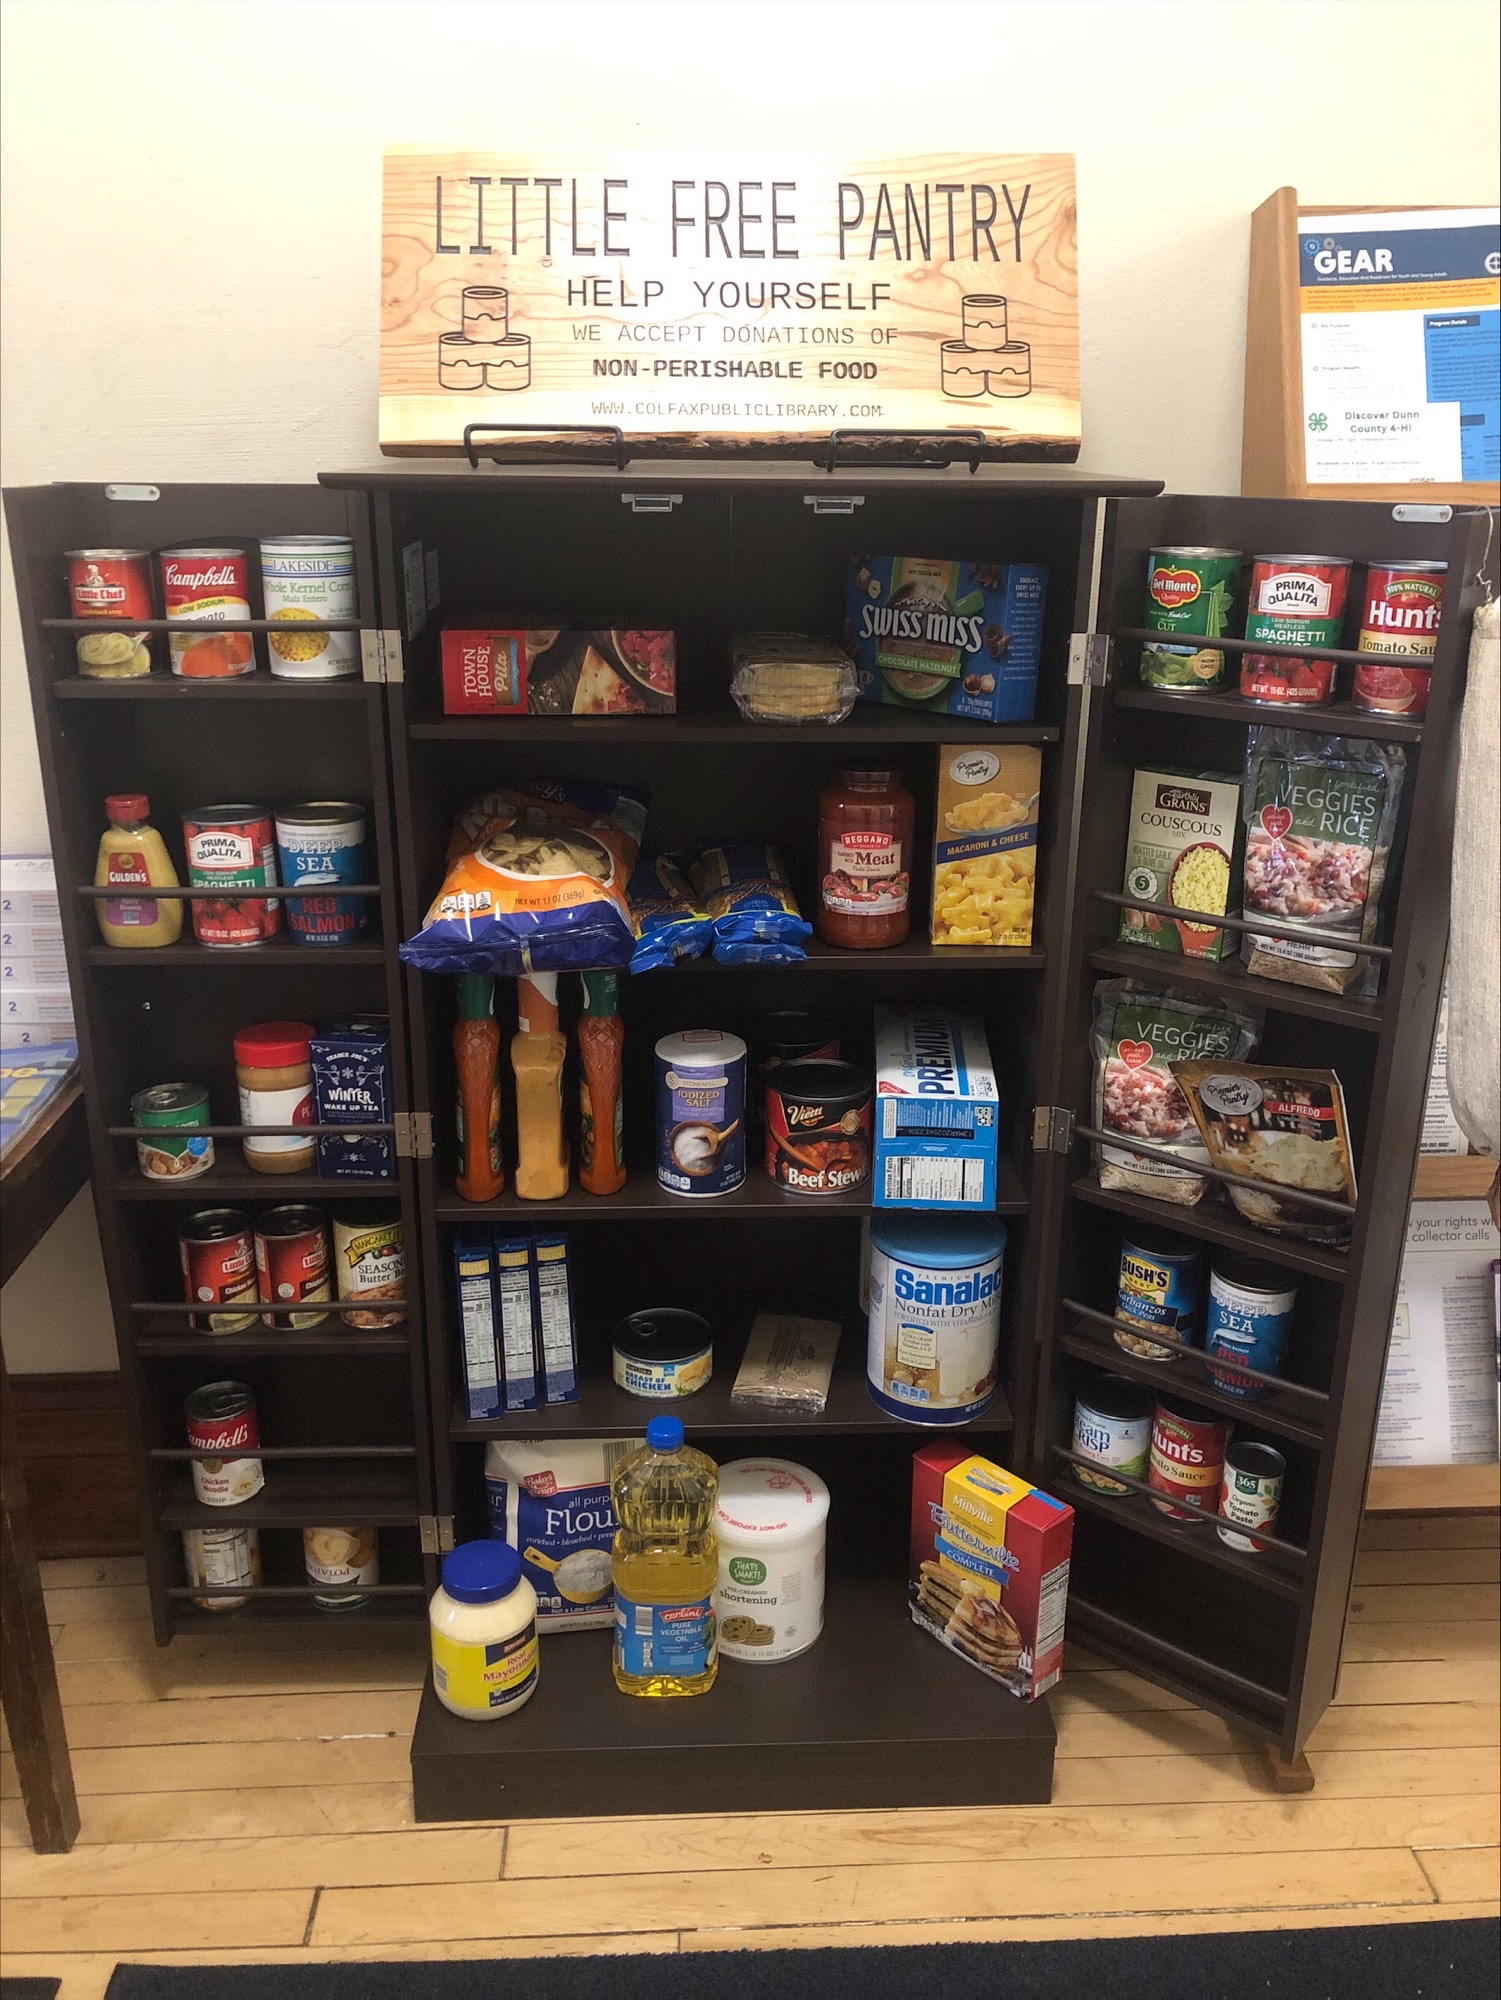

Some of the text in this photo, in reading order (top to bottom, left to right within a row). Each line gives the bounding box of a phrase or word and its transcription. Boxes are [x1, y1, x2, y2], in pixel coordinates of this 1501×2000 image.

[435, 176, 1032, 263] LITTLE FREE PANTRY
[1314, 249, 1393, 274] GEAR
[566, 280, 891, 310] HELP YOURSELF
[572, 324, 898, 345] WE ACCEPT DONATIONS OF
[593, 359, 877, 381] NON-PERISHABLE FOOD
[591, 402, 883, 419] WWW.COLFAXPUBLICLIBRARY.COM
[1345, 412, 1389, 420] Discover
[1351, 425, 1387, 434] County
[272, 560, 334, 572] LAKESIDE
[165, 564, 236, 590] Campbell's
[290, 582, 325, 593] Kernel
[1154, 579, 1197, 592] Del Monte
[1275, 581, 1315, 594] PRIMA
[1404, 583, 1437, 597] NATURAL
[77, 589, 123, 599] Little Chef
[1267, 593, 1319, 607] QUALITA
[179, 599, 225, 614] LOW SODIUM
[1158, 621, 1176, 631] CUT
[1255, 628, 1325, 642] SPAGHETTI
[1363, 637, 1406, 654] Tomato
[463, 648, 477, 696] TOWN
[478, 647, 492, 697] HOUSE
[494, 651, 508, 692] Pita
[878, 656, 956, 674] CHOCOLATE HAZELNUT
[1159, 792, 1206, 812] GRAINS
[1172, 791, 1200, 802] earthly
[1280, 783, 1376, 816] VEGGIES
[1141, 813, 1222, 837] COUSCOUS
[1295, 811, 1374, 839] and RICE
[201, 838, 236, 849] PRIMA
[288, 839, 342, 854] DEEP
[845, 836, 889, 845] REGGANO
[947, 832, 1029, 856] MACARONI & CHEESE
[197, 847, 242, 860] QUALITA
[1133, 844, 1155, 858] ROASTED
[296, 857, 335, 871] SEA
[855, 852, 895, 865] Meat
[110, 870, 147, 883] GULDEN'S
[193, 879, 255, 888] SPAGHETTI
[1139, 877, 1145, 888] 5
[3, 900, 11, 910] 2
[515, 890, 585, 906] NET WT 13 OZ (369g)
[290, 913, 355, 933] SALMON
[3, 934, 12, 944] 2
[4, 967, 13, 976] 2
[9, 1002, 17, 1012] 2
[22, 1032, 30, 1043] 2
[1137, 1022, 1230, 1051] VEGGIES
[326, 1052, 368, 1063] TRADER JOE'S
[914, 1020, 955, 1095] PREMIUM
[328, 1087, 374, 1105] WINTER
[678, 1090, 720, 1099] IODIZED
[1219, 1091, 1249, 1106] Pantry
[686, 1099, 711, 1107] SALT
[1278, 1104, 1320, 1117] ALFREDO
[788, 1168, 861, 1189] Beef Stew
[1416, 1215, 1478, 1231] your rights
[354, 1233, 392, 1250] MARGARET
[1412, 1229, 1490, 1242] collector calls
[224, 1260, 244, 1271] Little
[305, 1254, 322, 1266] Little
[359, 1273, 391, 1283] Butter
[1122, 1256, 1167, 1287] BUSH'S
[225, 1283, 245, 1294] Chicken
[305, 1279, 324, 1289] Chicken
[895, 1268, 1002, 1306] Sanalac
[895, 1295, 1000, 1318] Nonfat Dry Milk
[1118, 1289, 1167, 1316] Garbanzos
[1216, 1291, 1266, 1318] DEEP
[895, 1312, 985, 1327] FORTIFIED WITH VITAMINS
[1220, 1311, 1254, 1332] SEA
[626, 1371, 653, 1382] BREAST
[626, 1378, 671, 1390] CHICKEN
[1168, 1422, 1191, 1439] NATURAL
[201, 1476, 229, 1485] Chicken
[1171, 1467, 1206, 1481] Sauce
[203, 1485, 229, 1493] Noodle
[1237, 1476, 1256, 1489] 365
[569, 1496, 580, 1508] all
[1232, 1494, 1256, 1507] Organic
[953, 1494, 994, 1525] Millville
[1228, 1501, 1259, 1517] Tomato
[545, 1508, 620, 1535] Flou
[1231, 1511, 1253, 1524] Paste
[728, 1519, 757, 1531] EXPOSE
[526, 1534, 592, 1546] enriched bleached
[928, 1501, 1021, 1572] Buttermilk
[947, 1550, 994, 1578] COMPLETE
[720, 1590, 778, 1605] shortening
[664, 1608, 700, 1620] carlini
[661, 1626, 702, 1635] VEGETABLE
[507, 1650, 526, 1665] Real
